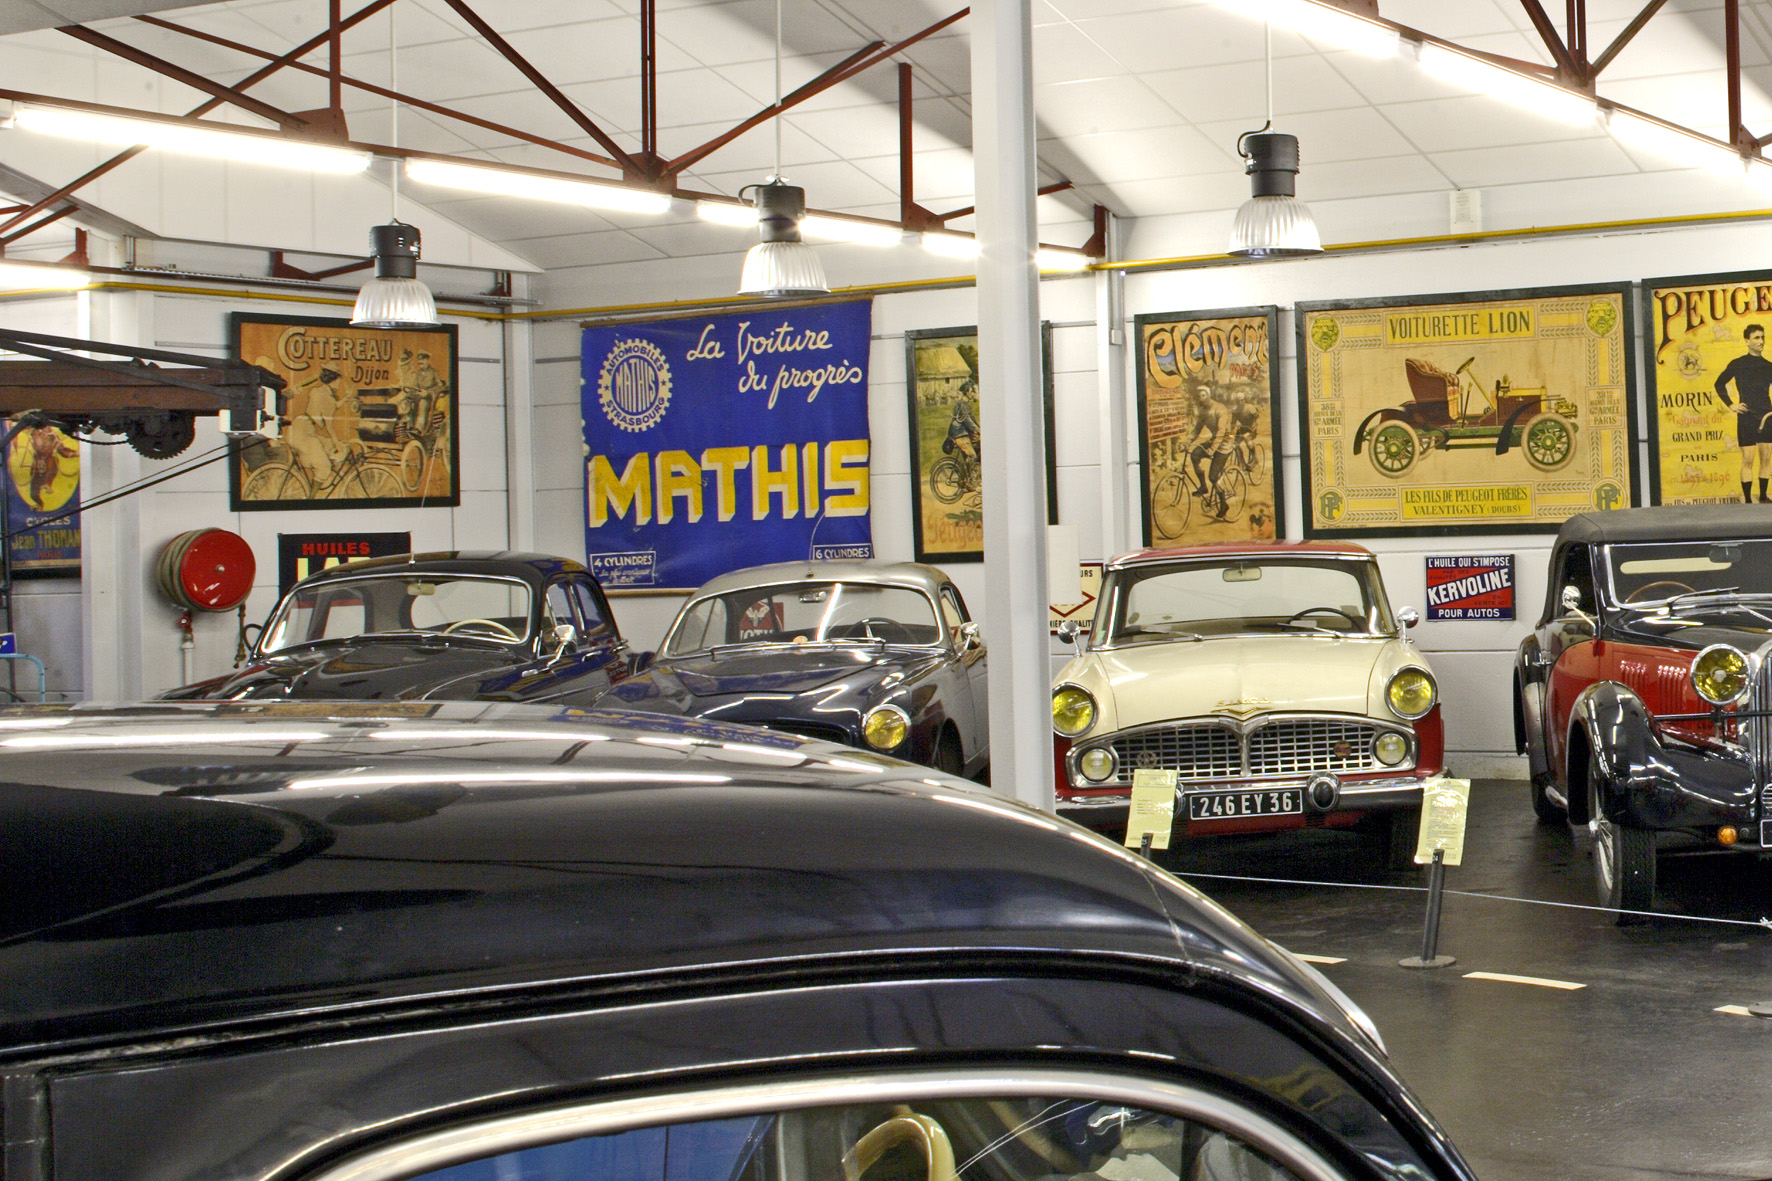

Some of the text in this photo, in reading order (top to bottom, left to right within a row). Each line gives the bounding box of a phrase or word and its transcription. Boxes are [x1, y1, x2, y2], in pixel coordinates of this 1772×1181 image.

[1389, 310, 1530, 339] VOITURETTE LION
[277, 326, 393, 371] COTTEREAU
[686, 321, 833, 365] La Voiture
[605, 345, 665, 376] AUTOMOBILES
[351, 365, 390, 385] Dijon
[615, 357, 656, 413] MATHIS
[738, 359, 863, 410] du progrès
[605, 397, 665, 426] STRASBOURG
[1660, 391, 1714, 414] MORIN
[1593, 415, 1617, 426] PARIS
[1317, 426, 1340, 436] PARIS
[1672, 431, 1702, 443] GRAND
[1680, 453, 1718, 463] PARIS
[588, 438, 870, 529] MATHIS
[1404, 490, 1421, 504] LES
[1423, 489, 1441, 503] FILS
[1443, 489, 1454, 503] DE
[1455, 488, 1496, 503] PEUGEOT
[1413, 504, 1487, 516] VALENTIGNEY
[302, 542, 371, 556] HUILES
[815, 547, 870, 560] 6 CYLINDRES
[594, 554, 653, 567] 4 CYLINDRES
[1428, 556, 1510, 568] L'HUILE QUI S'IMPOSE
[1427, 567, 1512, 606] KERVOLINE
[1438, 608, 1500, 618] POUR AUTOS
